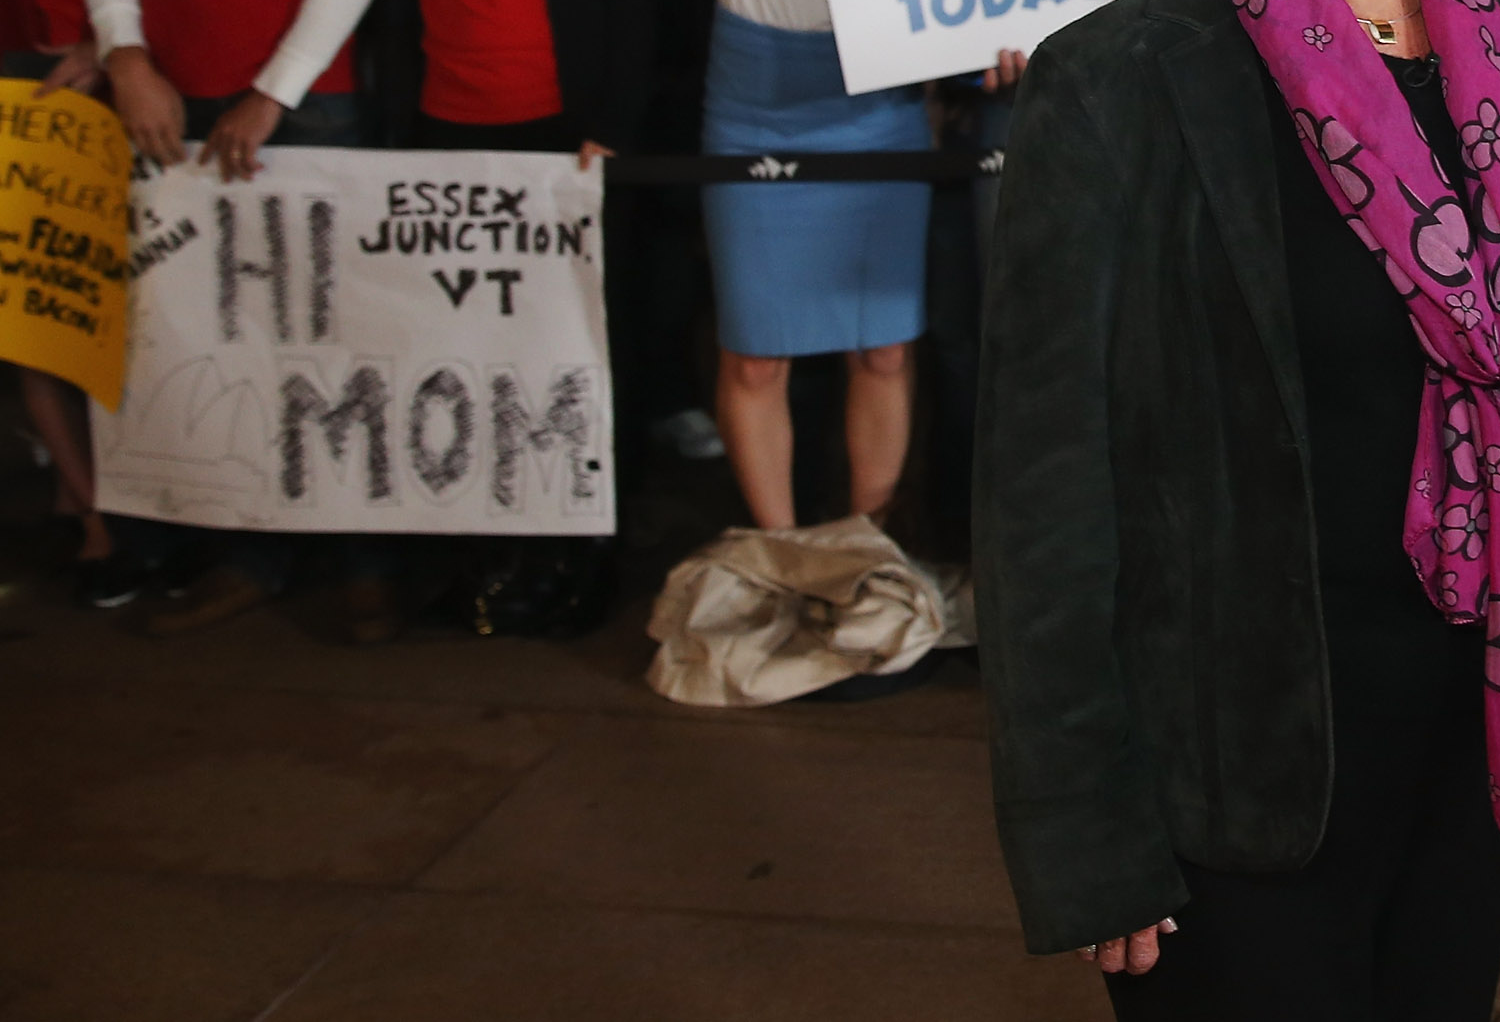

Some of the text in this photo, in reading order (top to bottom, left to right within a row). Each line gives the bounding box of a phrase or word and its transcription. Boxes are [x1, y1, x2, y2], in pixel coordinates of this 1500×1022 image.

[387, 181, 527, 217] ESSEX
[214, 193, 335, 343] HI
[432, 267, 522, 316] VT
[276, 360, 603, 512] MOM
